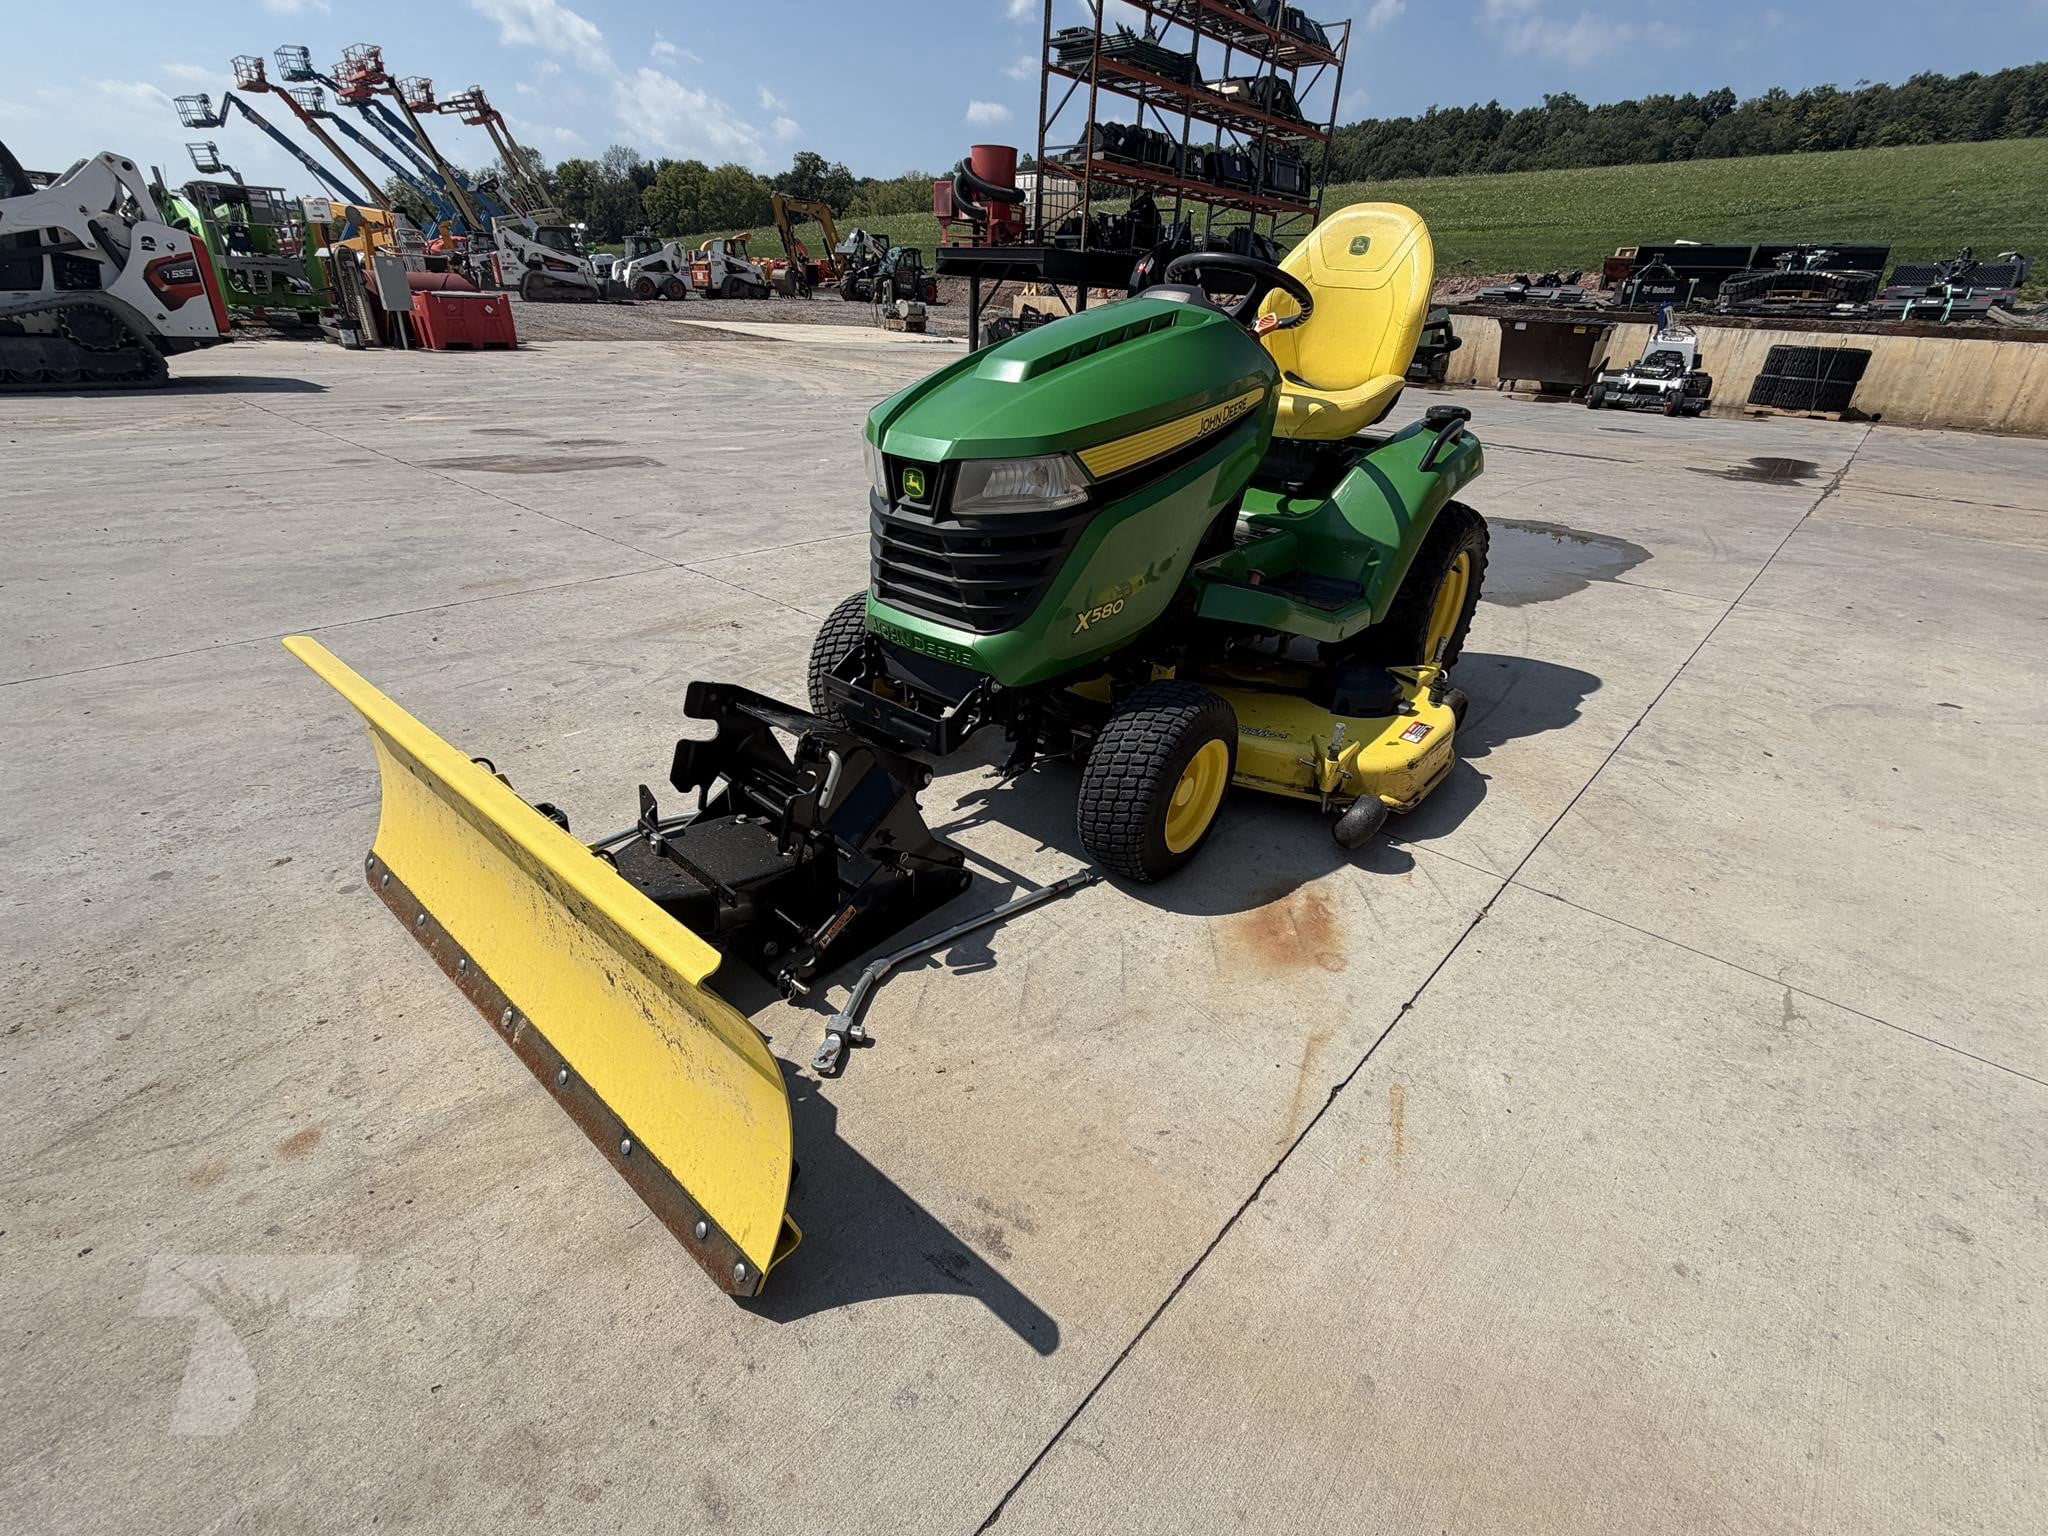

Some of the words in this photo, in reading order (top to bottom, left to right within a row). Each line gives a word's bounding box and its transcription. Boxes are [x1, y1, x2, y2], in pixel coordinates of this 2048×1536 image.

[1652, 285, 1676, 294] Bobcat
[1197, 412, 1222, 436] JOHN
[1222, 397, 1248, 420] DEERE
[1072, 598, 1124, 634] X580
[873, 618, 912, 647] JOHN
[913, 635, 974, 666] DEERE
